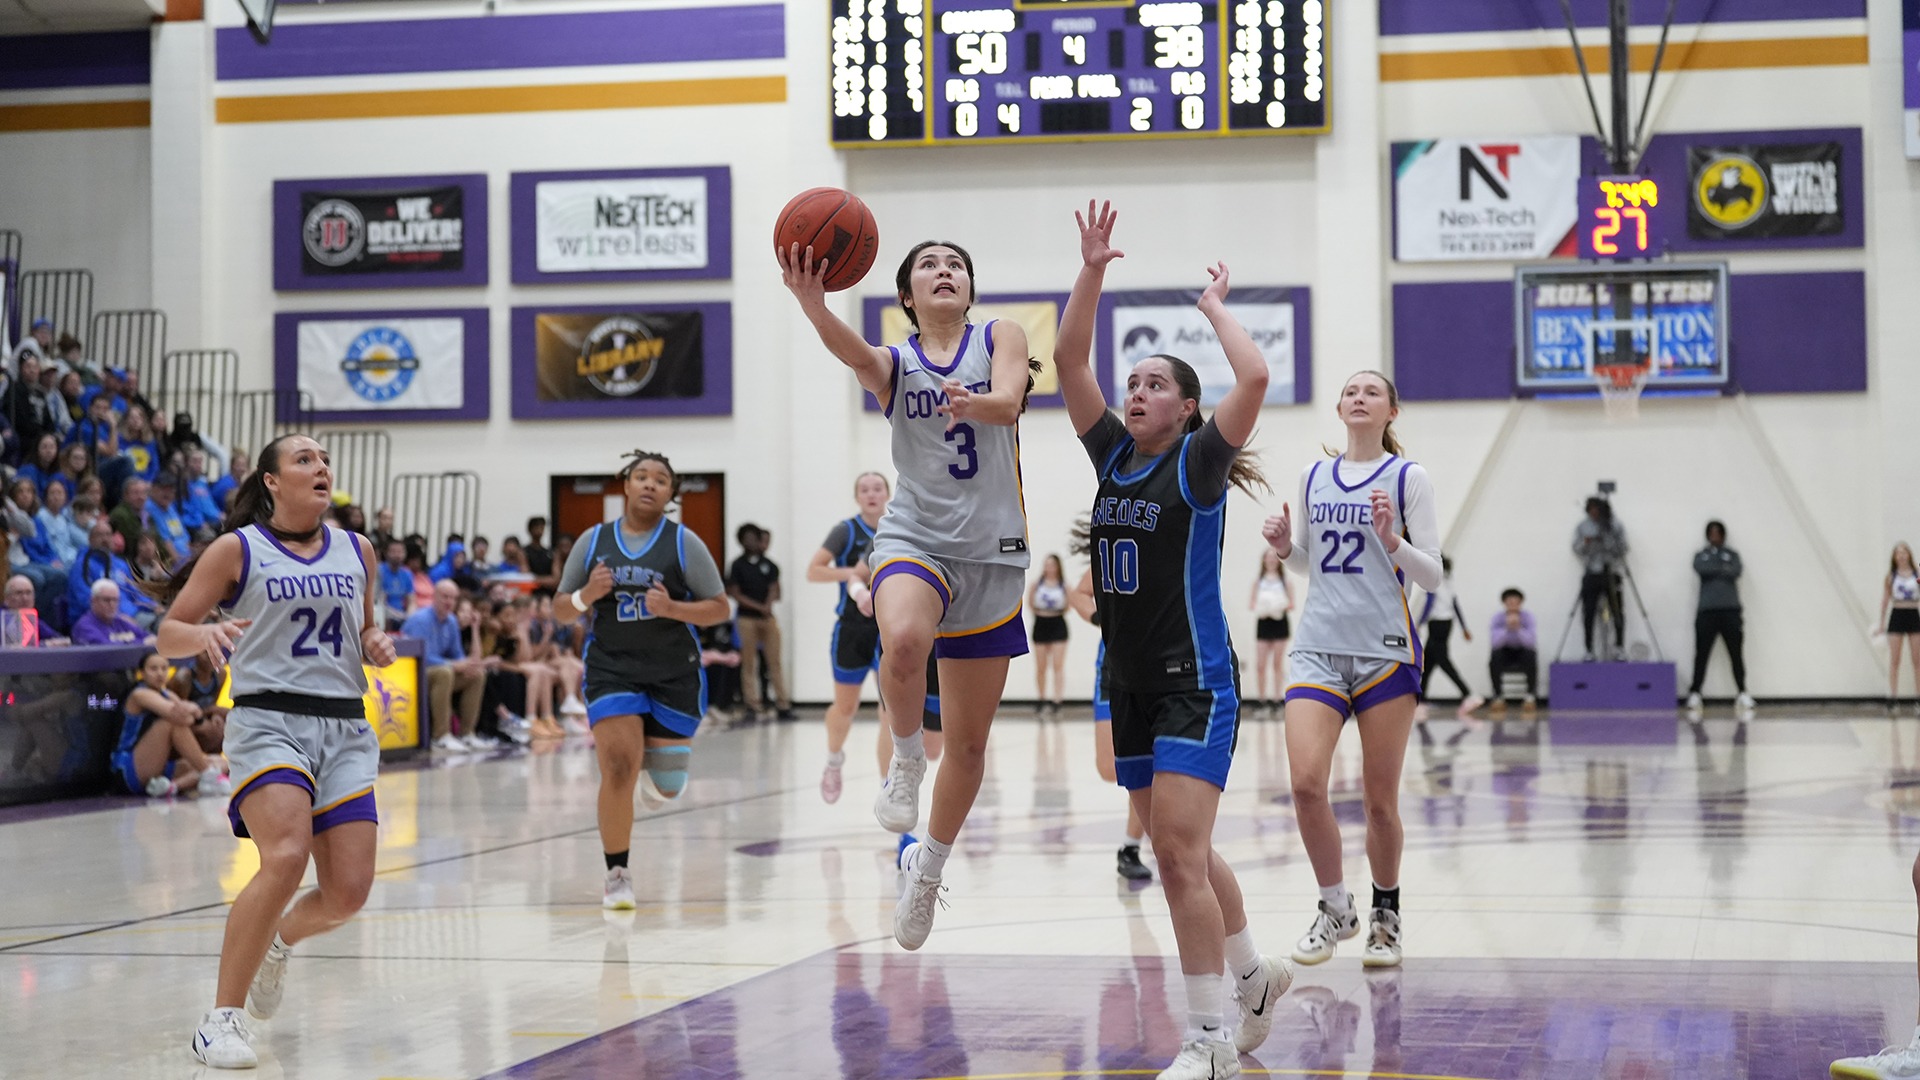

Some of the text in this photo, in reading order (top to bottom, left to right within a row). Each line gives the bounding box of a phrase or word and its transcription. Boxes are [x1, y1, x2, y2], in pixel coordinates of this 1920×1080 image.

[956, 33, 1007, 75] 50
[1063, 35, 1086, 65] 4
[1154, 25, 1204, 69] 38
[956, 102, 978, 136] 0
[997, 103, 1020, 132] 4
[1130, 97, 1152, 131] 2
[1181, 95, 1204, 129] 0
[396, 196, 433, 220] WE
[367, 218, 463, 246] DELIVER!
[556, 233, 696, 256] wireless
[1592, 207, 1648, 254] 27
[944, 422, 979, 480] 3
[1091, 497, 1161, 532] WEDES
[1099, 538, 1139, 595] 10
[1321, 530, 1365, 574] 22
[265, 573, 354, 603] COYOTES
[290, 606, 343, 658] 24
